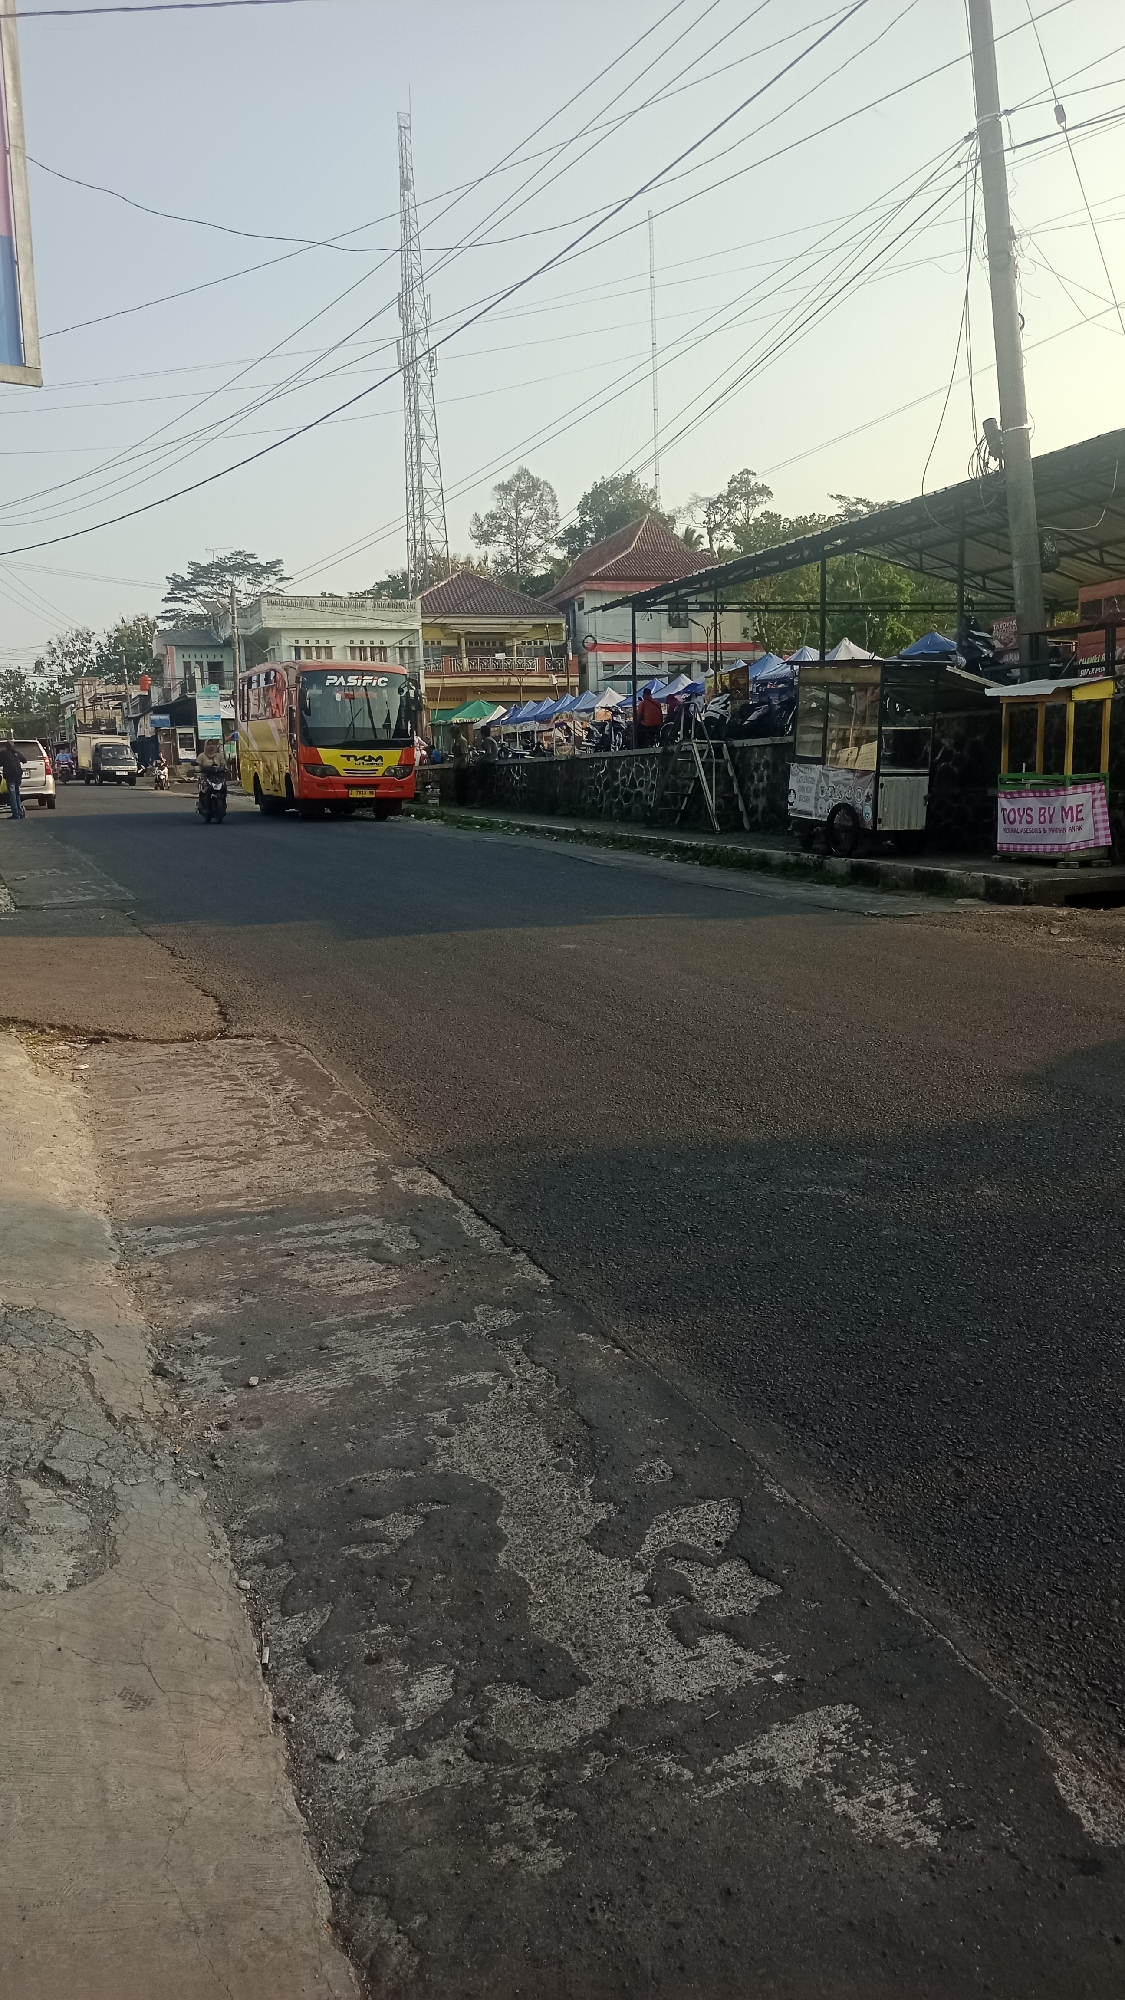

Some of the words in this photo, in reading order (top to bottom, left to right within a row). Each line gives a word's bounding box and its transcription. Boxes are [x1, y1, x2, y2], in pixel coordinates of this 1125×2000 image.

[1001, 807, 1034, 825] TOYS
[1038, 807, 1055, 825] BY
[1061, 803, 1084, 824] ME
